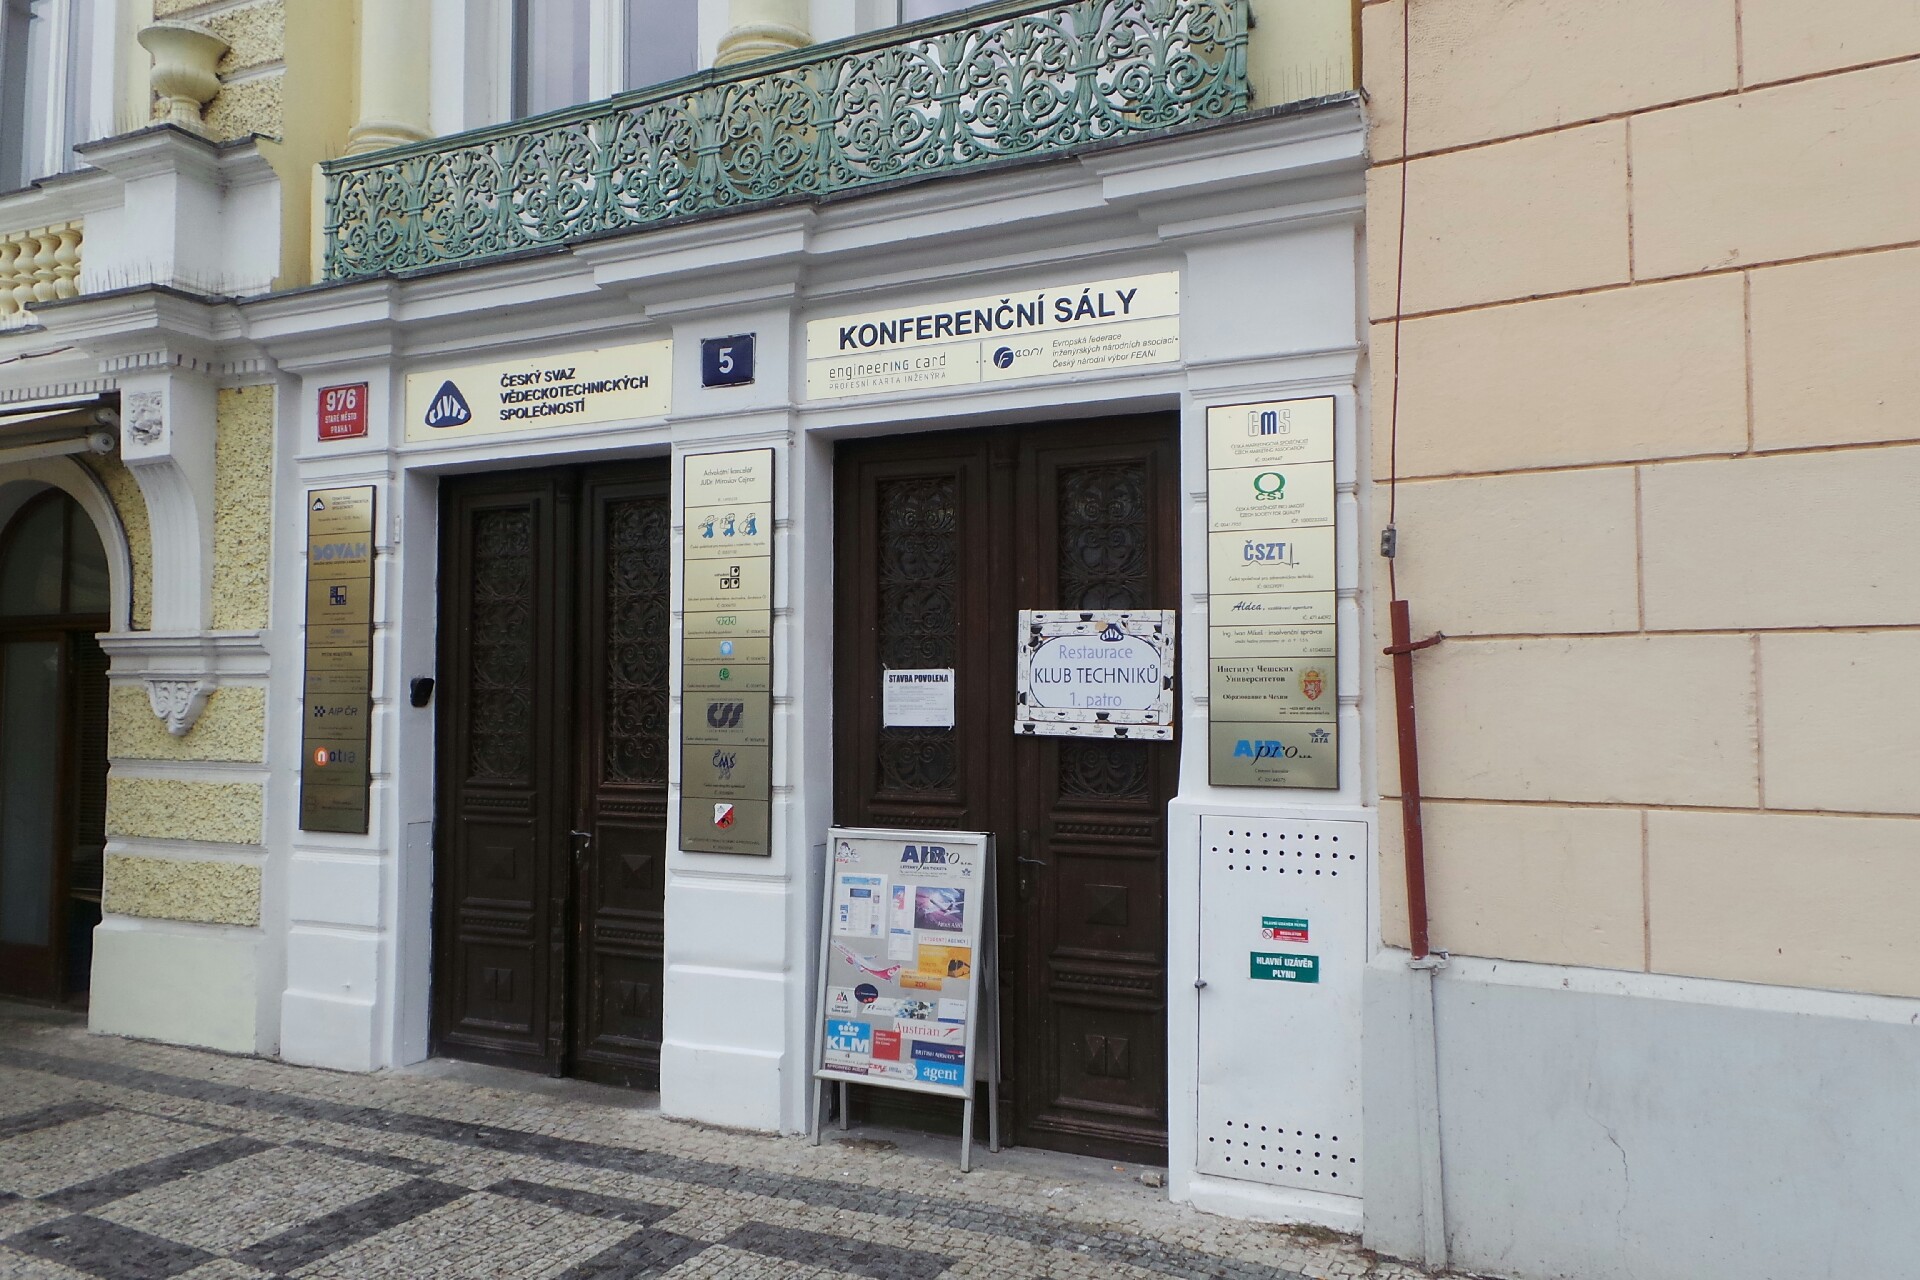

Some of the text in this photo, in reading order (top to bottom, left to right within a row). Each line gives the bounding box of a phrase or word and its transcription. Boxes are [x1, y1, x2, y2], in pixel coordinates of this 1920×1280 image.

[839, 287, 1138, 350] KONFERENČNÍ SÁLY
[1052, 333, 1122, 348] Evropská federace
[1052, 345, 1101, 357] inženýrských
[1102, 341, 1141, 351] národních
[718, 347, 735, 374] 5
[915, 351, 946, 369] card
[1052, 349, 1157, 369] Český národní výbor FEANI
[500, 368, 576, 388] ČESKÝ SVAZ
[872, 375, 901, 386] KARTA
[904, 372, 946, 383] INŽENÝRA
[499, 375, 649, 404] VĚDECKOTECHNICKÝCH
[326, 389, 356, 412] 976
[499, 397, 586, 421] SPOLEČNOSTÍ
[325, 411, 357, 424] STARÉ MĚSTO
[330, 425, 352, 434] PRAHA 1
[1243, 540, 1287, 561] ČSZT
[1059, 644, 1133, 660] Restaurace
[1034, 663, 1159, 684] KLUB TECHNIKŮ
[1217, 664, 1294, 675] Институт Чешских
[888, 674, 949, 684] STAVBA POVOLENA
[1225, 674, 1286, 685] Университетов
[1070, 692, 1122, 707] 1. patro
[1256, 956, 1313, 969] HLAVNÍ UZÁVĚR
[1272, 969, 1297, 979] PLYNU
[893, 1022, 941, 1037] Austrian
[827, 1035, 869, 1053] KLM
[915, 1049, 935, 1057] BRITISH
[923, 1065, 958, 1081] agent
